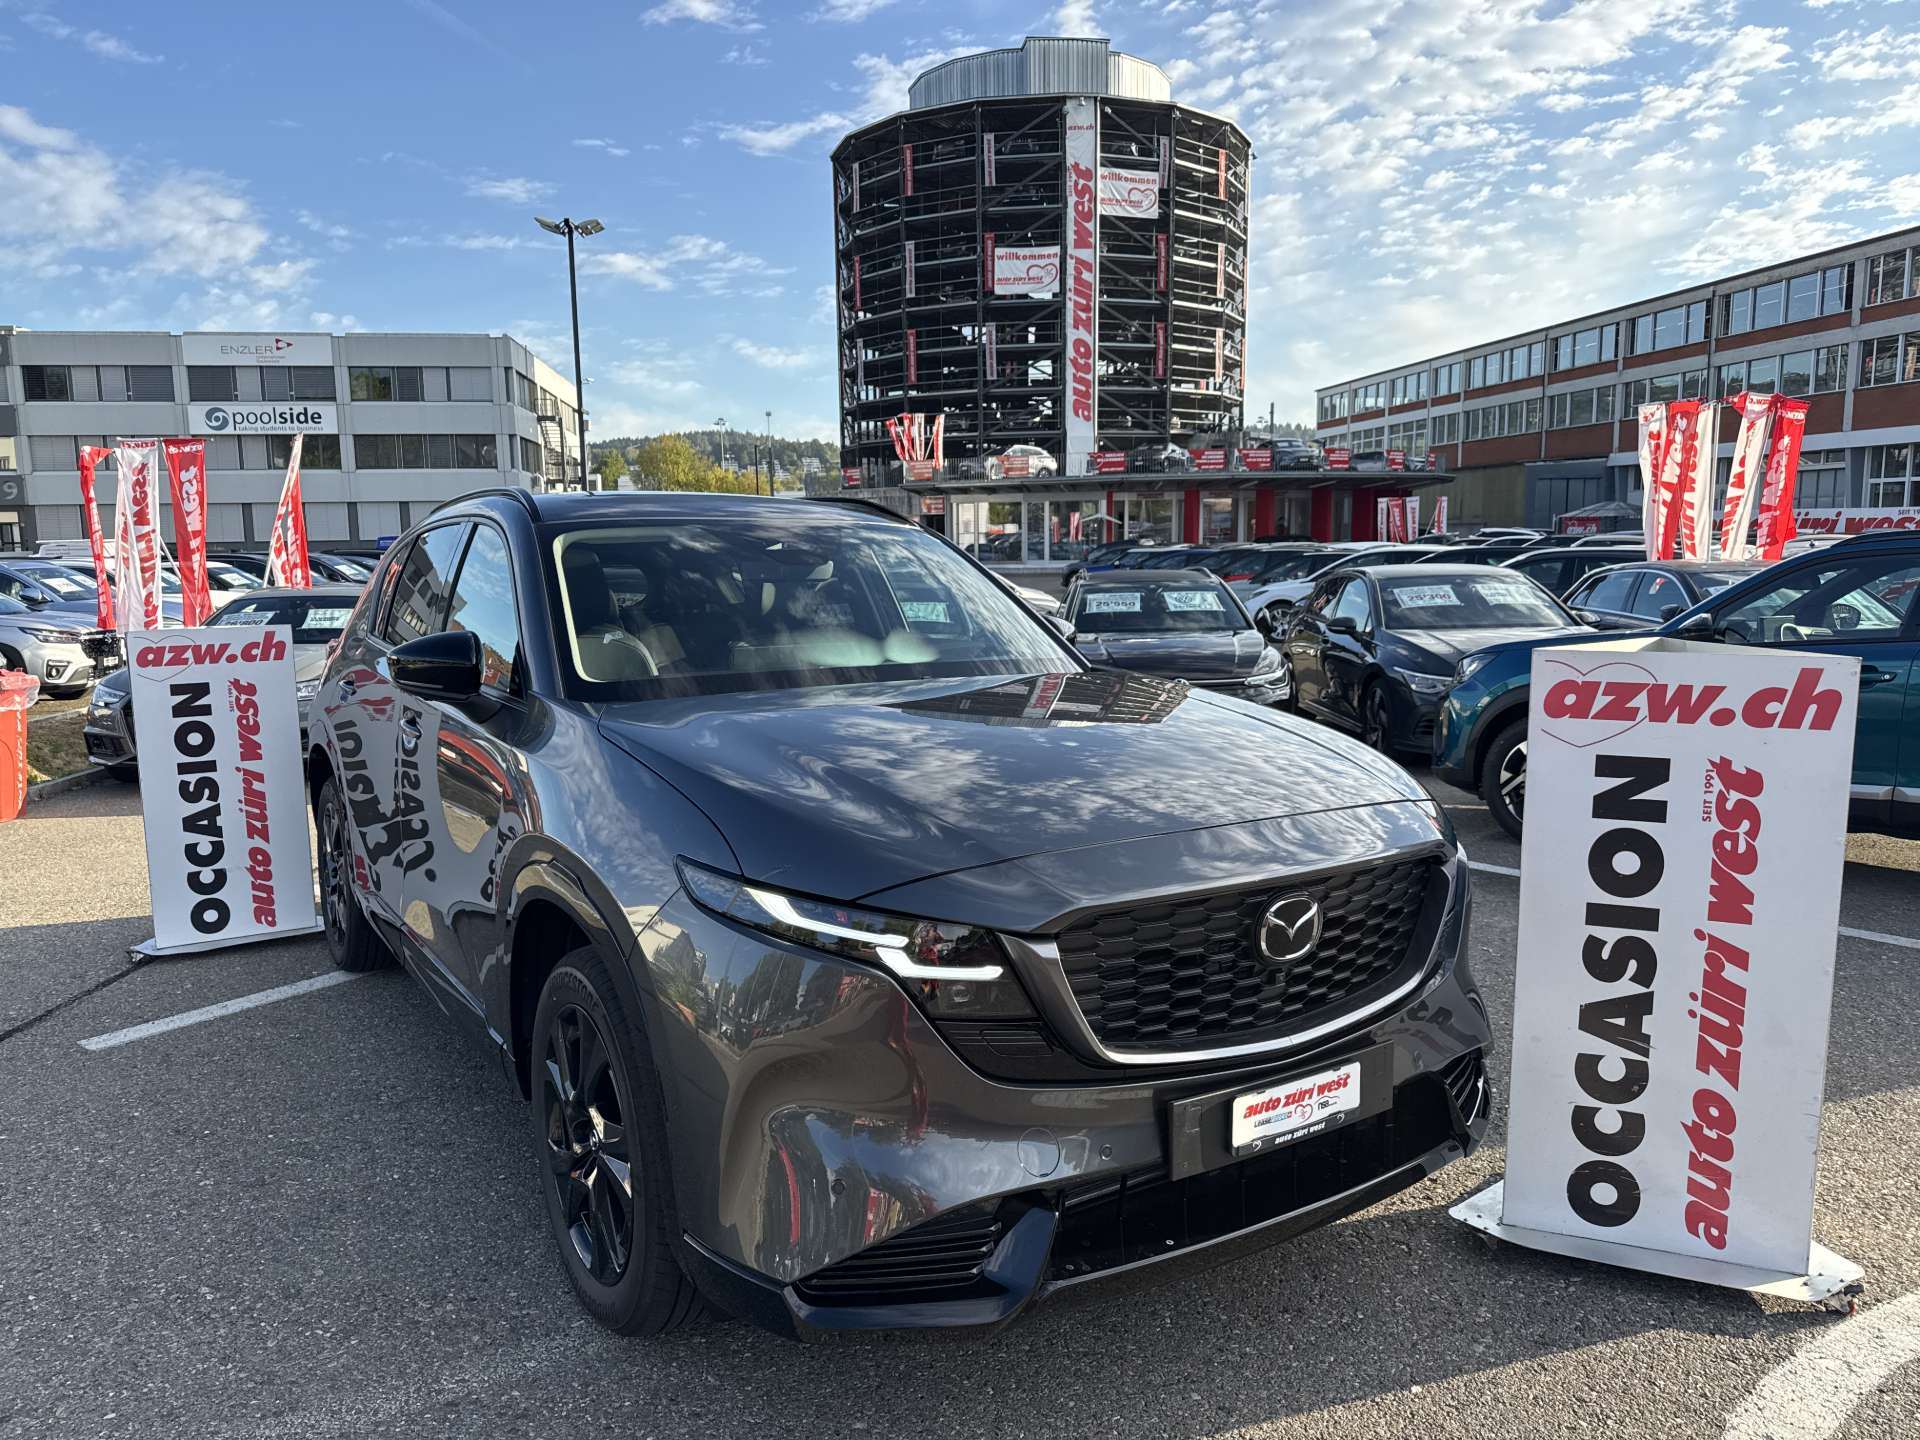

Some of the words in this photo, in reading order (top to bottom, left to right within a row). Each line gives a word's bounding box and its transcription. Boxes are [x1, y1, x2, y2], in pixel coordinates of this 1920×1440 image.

[1069, 161, 1094, 250] west
[1101, 173, 1157, 185] willkommen
[996, 251, 1058, 261] willkommen
[1068, 253, 1093, 336] züri
[220, 345, 273, 354] ENZLER
[1069, 338, 1093, 422] auto
[232, 406, 322, 431] poolside
[3, 481, 18, 500] 9
[135, 630, 287, 669] azw.ch
[227, 677, 263, 762] west
[1542, 667, 1843, 731] azw.ch
[170, 681, 231, 934] OCCASION
[234, 766, 270, 845] züri
[1702, 798, 1712, 822] SEIT
[1703, 768, 1714, 795] 1991
[1707, 755, 1764, 926] west
[244, 846, 277, 928] auto
[1566, 753, 1672, 1228] OCCASION
[1686, 927, 1751, 1092] züri
[1243, 1097, 1282, 1119] auto
[1282, 1083, 1316, 1108] züri
[1316, 1073, 1351, 1097] west
[1274, 1133, 1292, 1145] auto
[1309, 1122, 1326, 1134] west
[1680, 1098, 1740, 1252] auto
